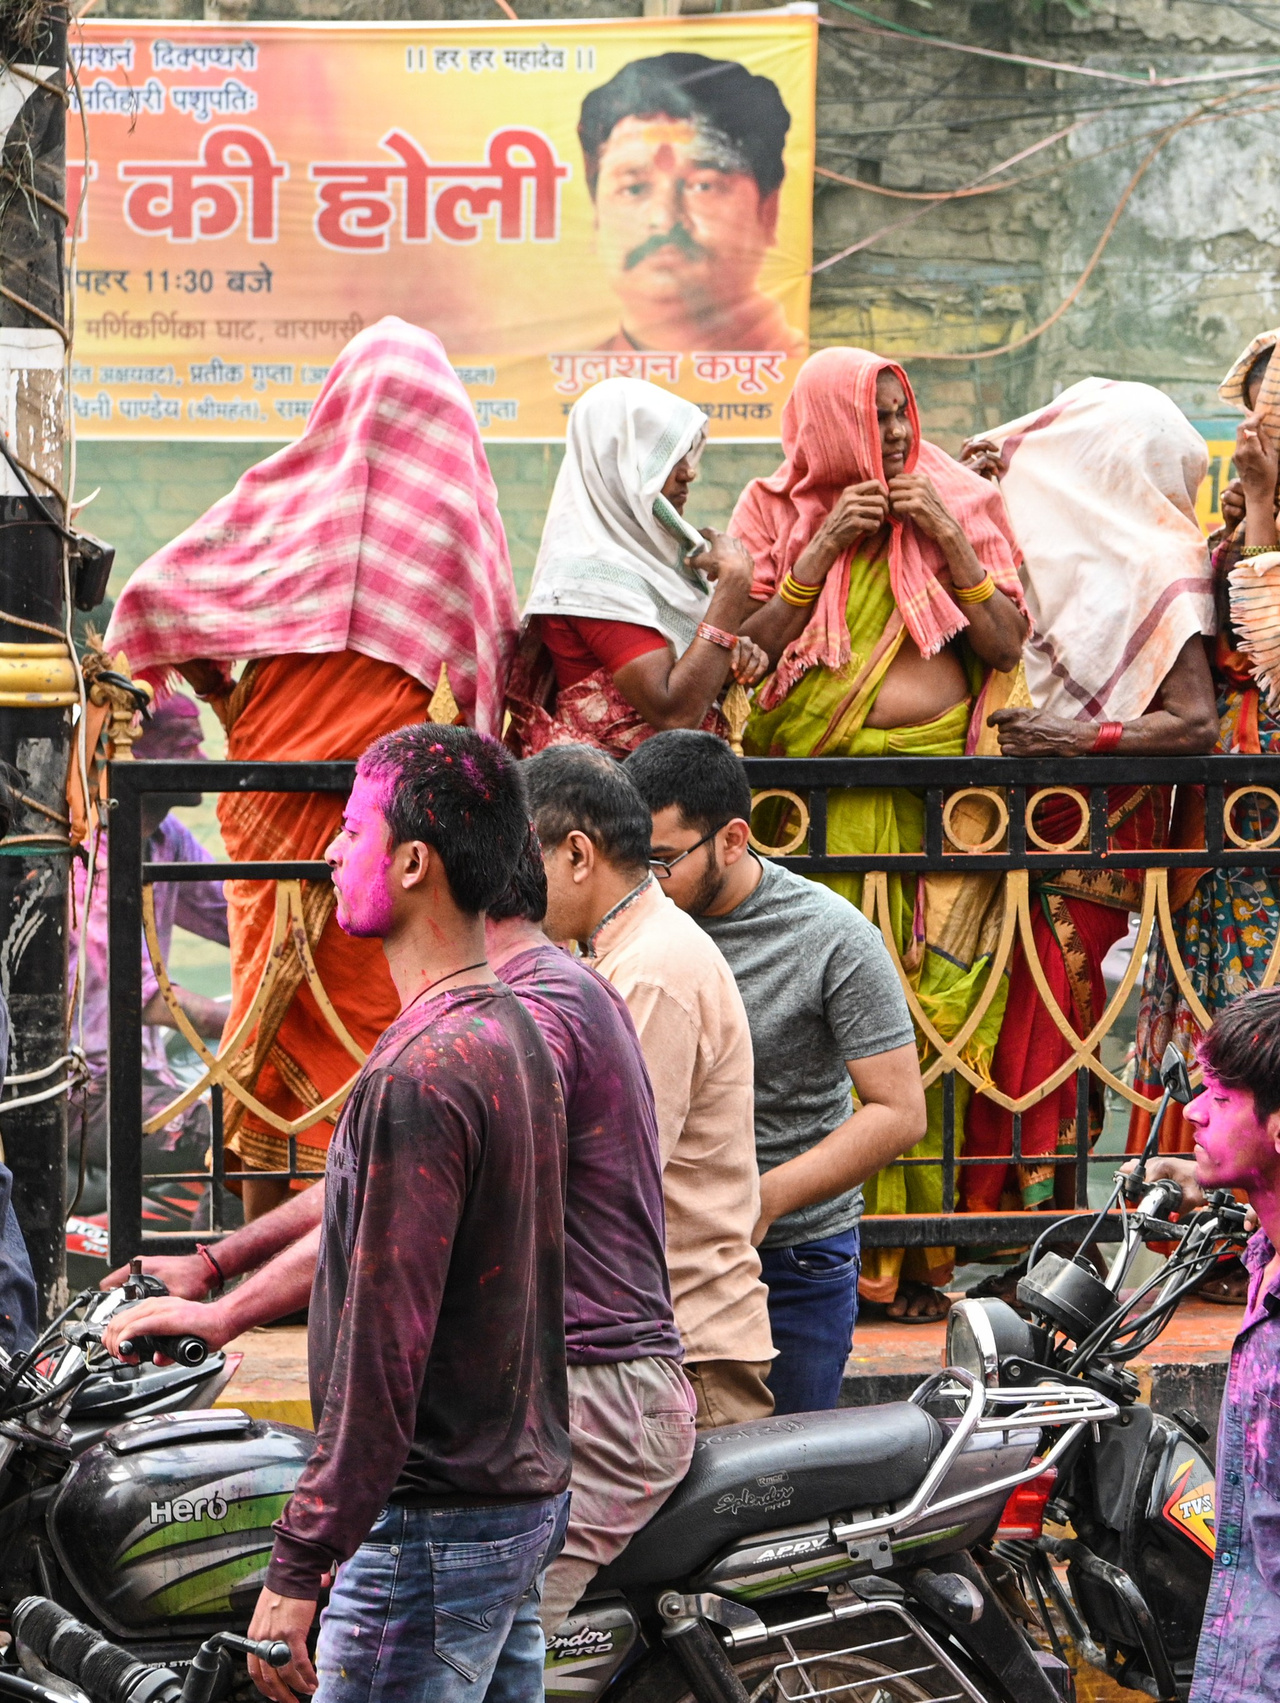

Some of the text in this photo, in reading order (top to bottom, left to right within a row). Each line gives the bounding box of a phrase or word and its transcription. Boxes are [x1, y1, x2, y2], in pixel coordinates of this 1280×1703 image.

[69, 39, 133, 67] मशनं
[434, 49, 461, 71] हर
[469, 49, 495, 71] हर
[504, 43, 565, 71] महादेव
[173, 81, 256, 120] पशुपतिः
[120, 124, 288, 243] की
[310, 124, 571, 253] होली
[64, 262, 274, 296] पहर 11:30 बजे
[273, 311, 364, 340] वाराणसी
[189, 357, 244, 383] प्रतीक
[251, 363, 293, 391] गुप्ता
[549, 352, 787, 395] गुलशन कपूर
[275, 399, 313, 420] राम
[475, 400, 518, 427] गुप्ता
[149, 1496, 228, 1524] Hero
[713, 1486, 794, 1515] Splendor
[764, 1499, 791, 1512] PRO
[1179, 1494, 1212, 1520] TVS
[756, 1537, 830, 1560] APDV
[546, 1626, 612, 1650] endor
[558, 1642, 614, 1658] PRO
